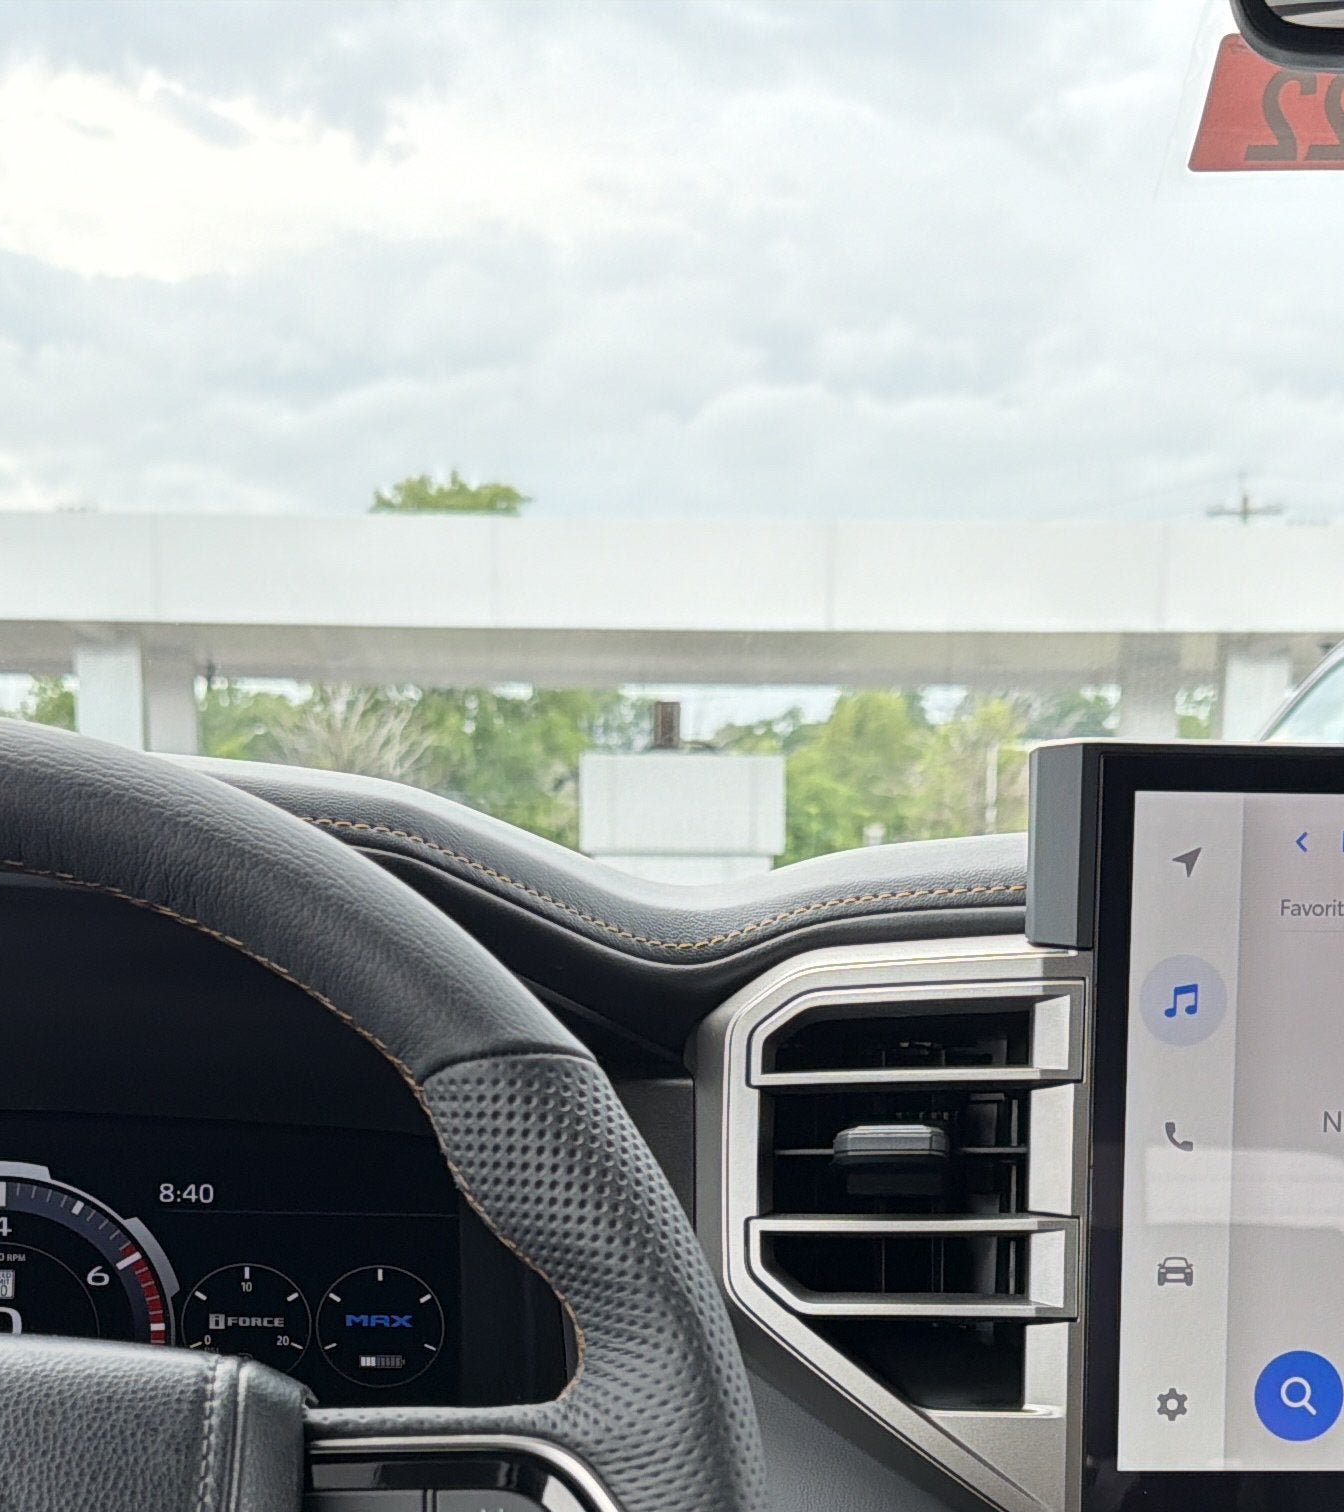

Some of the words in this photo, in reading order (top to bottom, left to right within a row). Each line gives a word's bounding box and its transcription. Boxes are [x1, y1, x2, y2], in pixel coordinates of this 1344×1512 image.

[158, 1183, 214, 1203] 8:40
[6, 1252, 26, 1262] RPM
[86, 1265, 110, 1287] 6
[241, 1281, 253, 1292] 10
[345, 1314, 414, 1327] MAX
[203, 1334, 212, 1345] 0
[276, 1335, 290, 1346] 20
